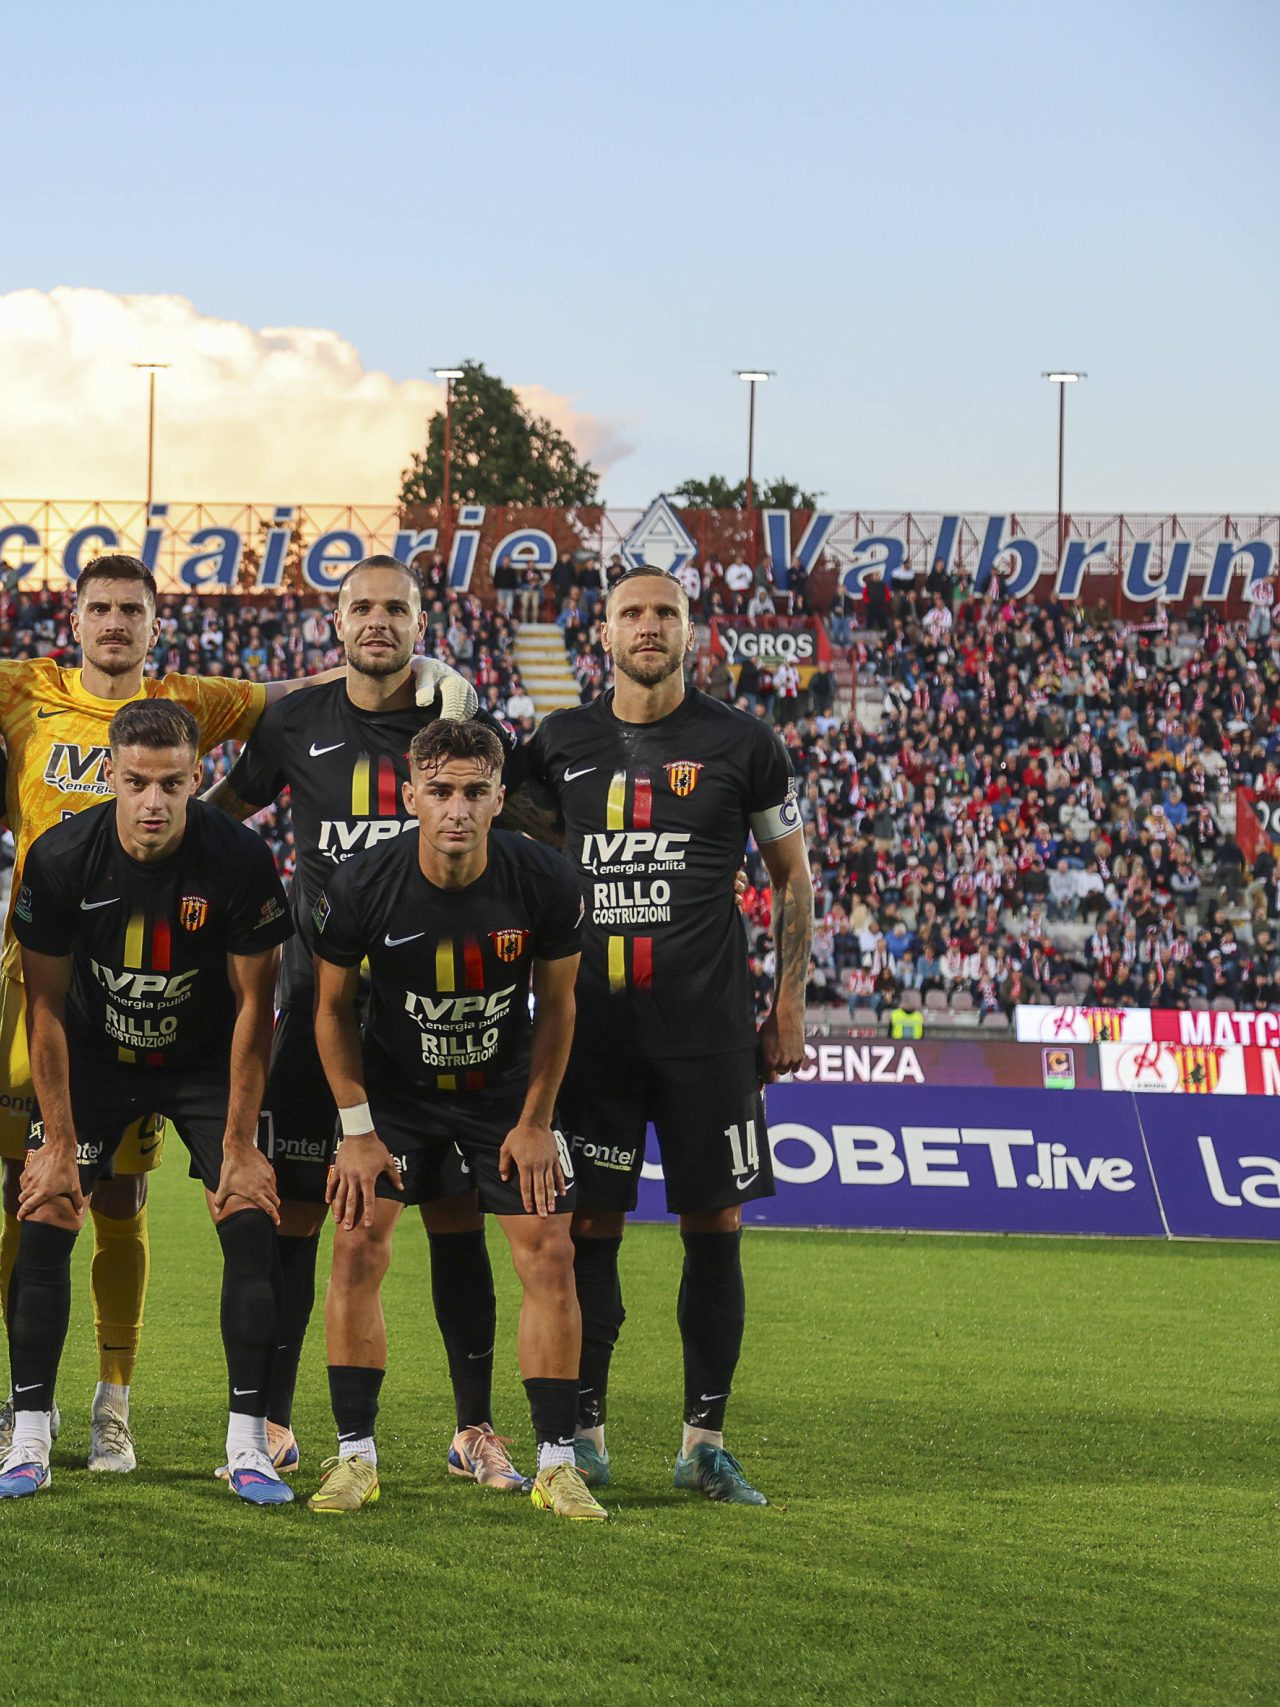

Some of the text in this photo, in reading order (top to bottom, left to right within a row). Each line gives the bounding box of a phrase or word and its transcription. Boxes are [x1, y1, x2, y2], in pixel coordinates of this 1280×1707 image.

[581, 831, 691, 864] IVPC
[599, 860, 686, 875] energia pulita
[593, 879, 671, 909] RILLO
[592, 905, 671, 925] COSTRUZIONI
[90, 958, 200, 999] IVPC
[404, 983, 517, 1022] IVPC
[104, 1022, 177, 1048] COSTRUZIONI
[106, 1003, 178, 1037] RILLO
[425, 1021, 476, 1033] energia
[420, 1027, 499, 1056] RILLO
[422, 1042, 498, 1067] COSTRUZIONI
[569, 1134, 637, 1166] Fontel
[724, 1119, 760, 1177] 14
